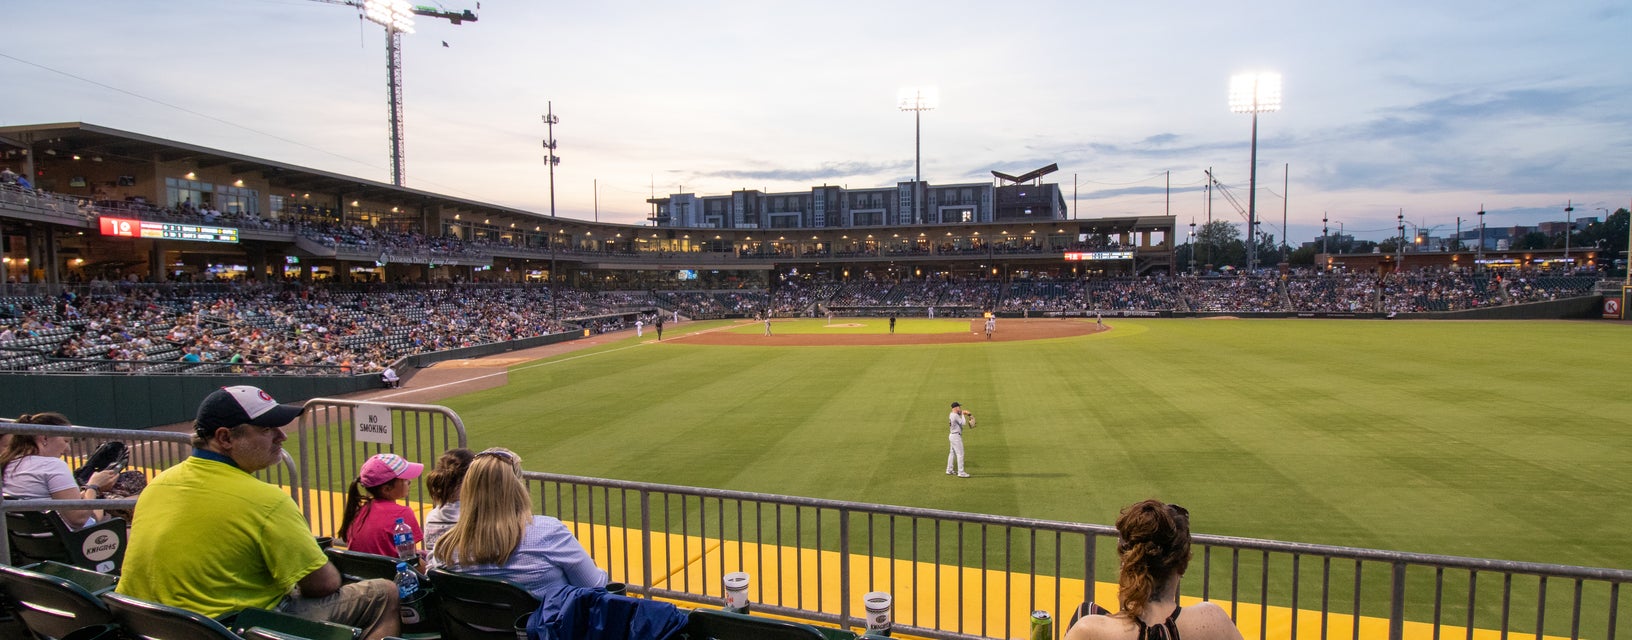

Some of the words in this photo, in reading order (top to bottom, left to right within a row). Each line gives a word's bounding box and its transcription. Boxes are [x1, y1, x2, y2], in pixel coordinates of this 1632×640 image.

[111, 220, 118, 234] 1
[1608, 303, 1616, 312] K
[368, 415, 378, 424] NO
[360, 423, 387, 434] SMOKING
